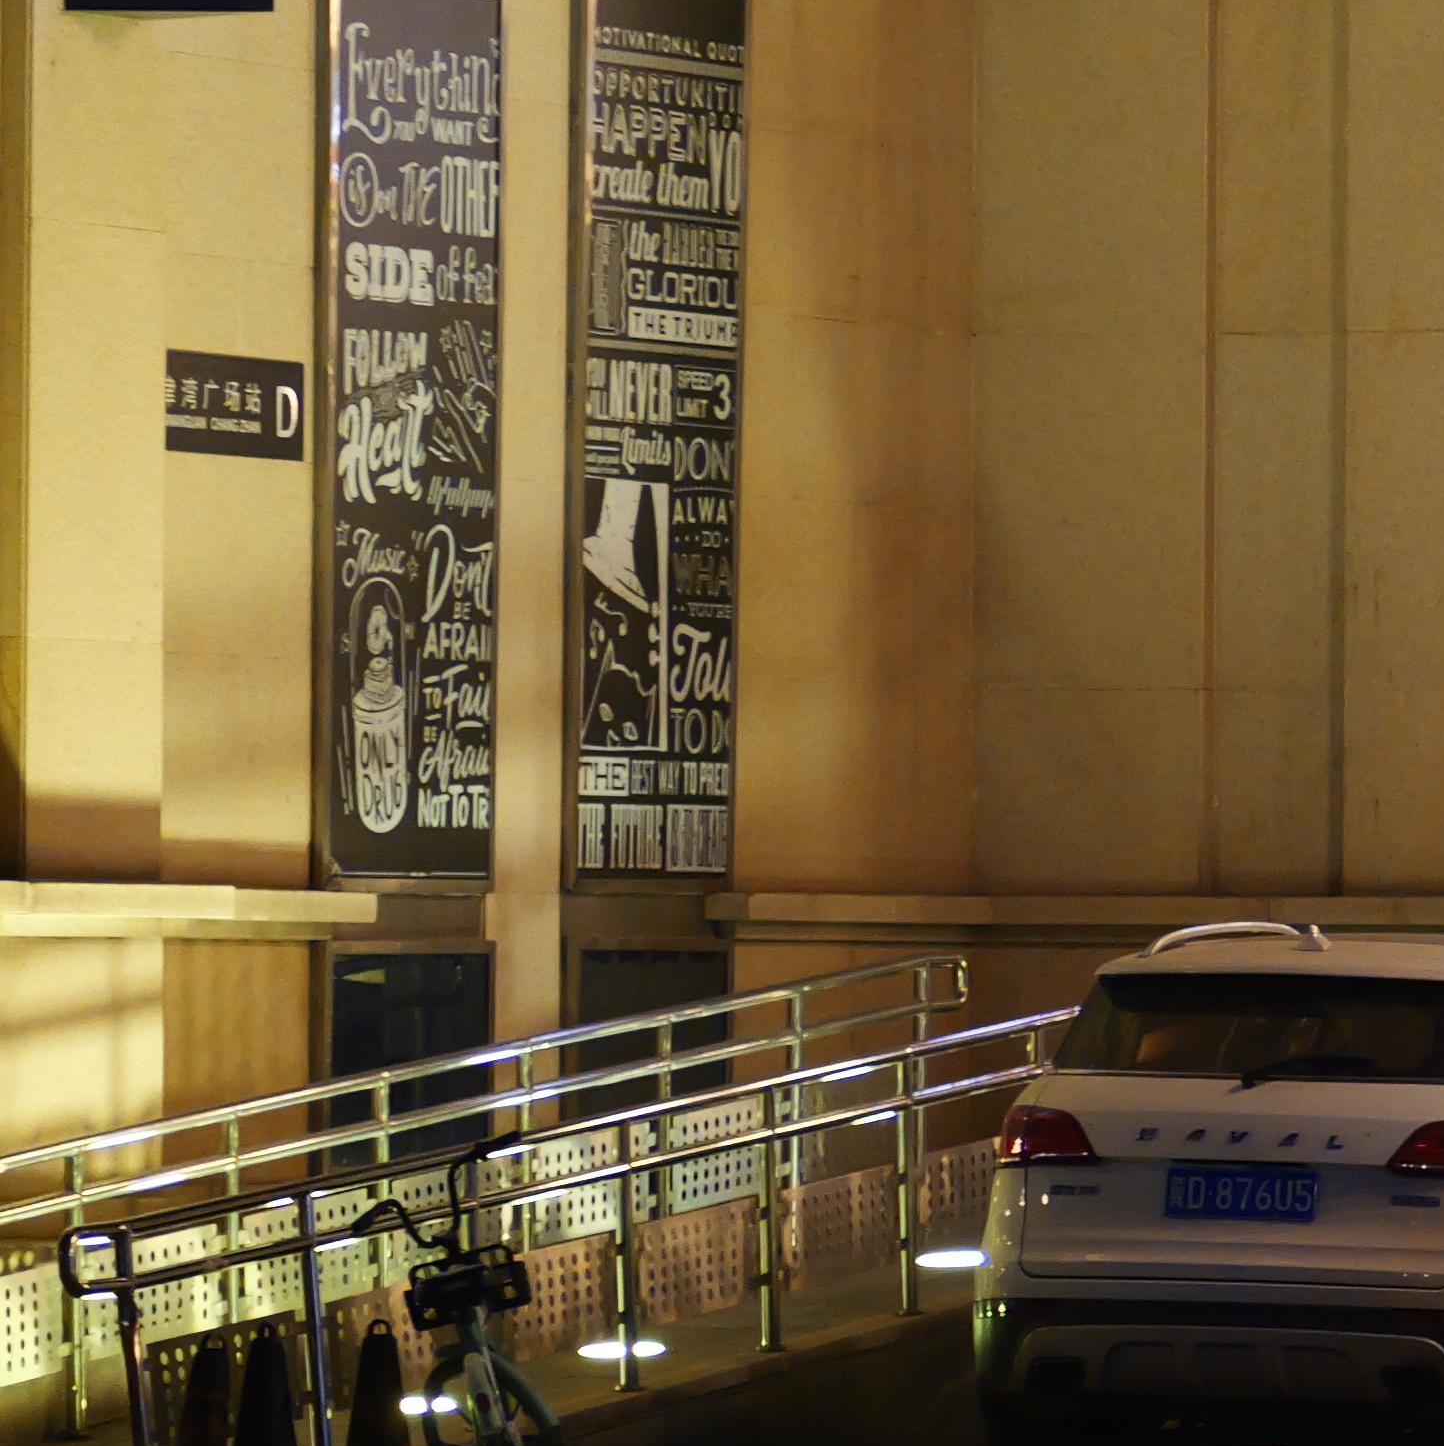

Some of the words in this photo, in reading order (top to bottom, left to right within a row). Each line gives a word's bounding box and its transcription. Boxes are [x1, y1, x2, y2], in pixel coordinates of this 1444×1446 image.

[629, 219, 662, 263] the
[344, 241, 436, 307] SIDE
[436, 244, 460, 303] of
[463, 246, 499, 306] fea
[632, 311, 668, 335] THE
[275, 385, 299, 438] D
[609, 358, 673, 426] NEVER
[423, 621, 492, 662] AFRAI
[422, 687, 443, 710] TO
[669, 708, 708, 755] TO
[578, 761, 627, 792] THE
[417, 785, 450, 829] NOT
[448, 784, 470, 829] TO
